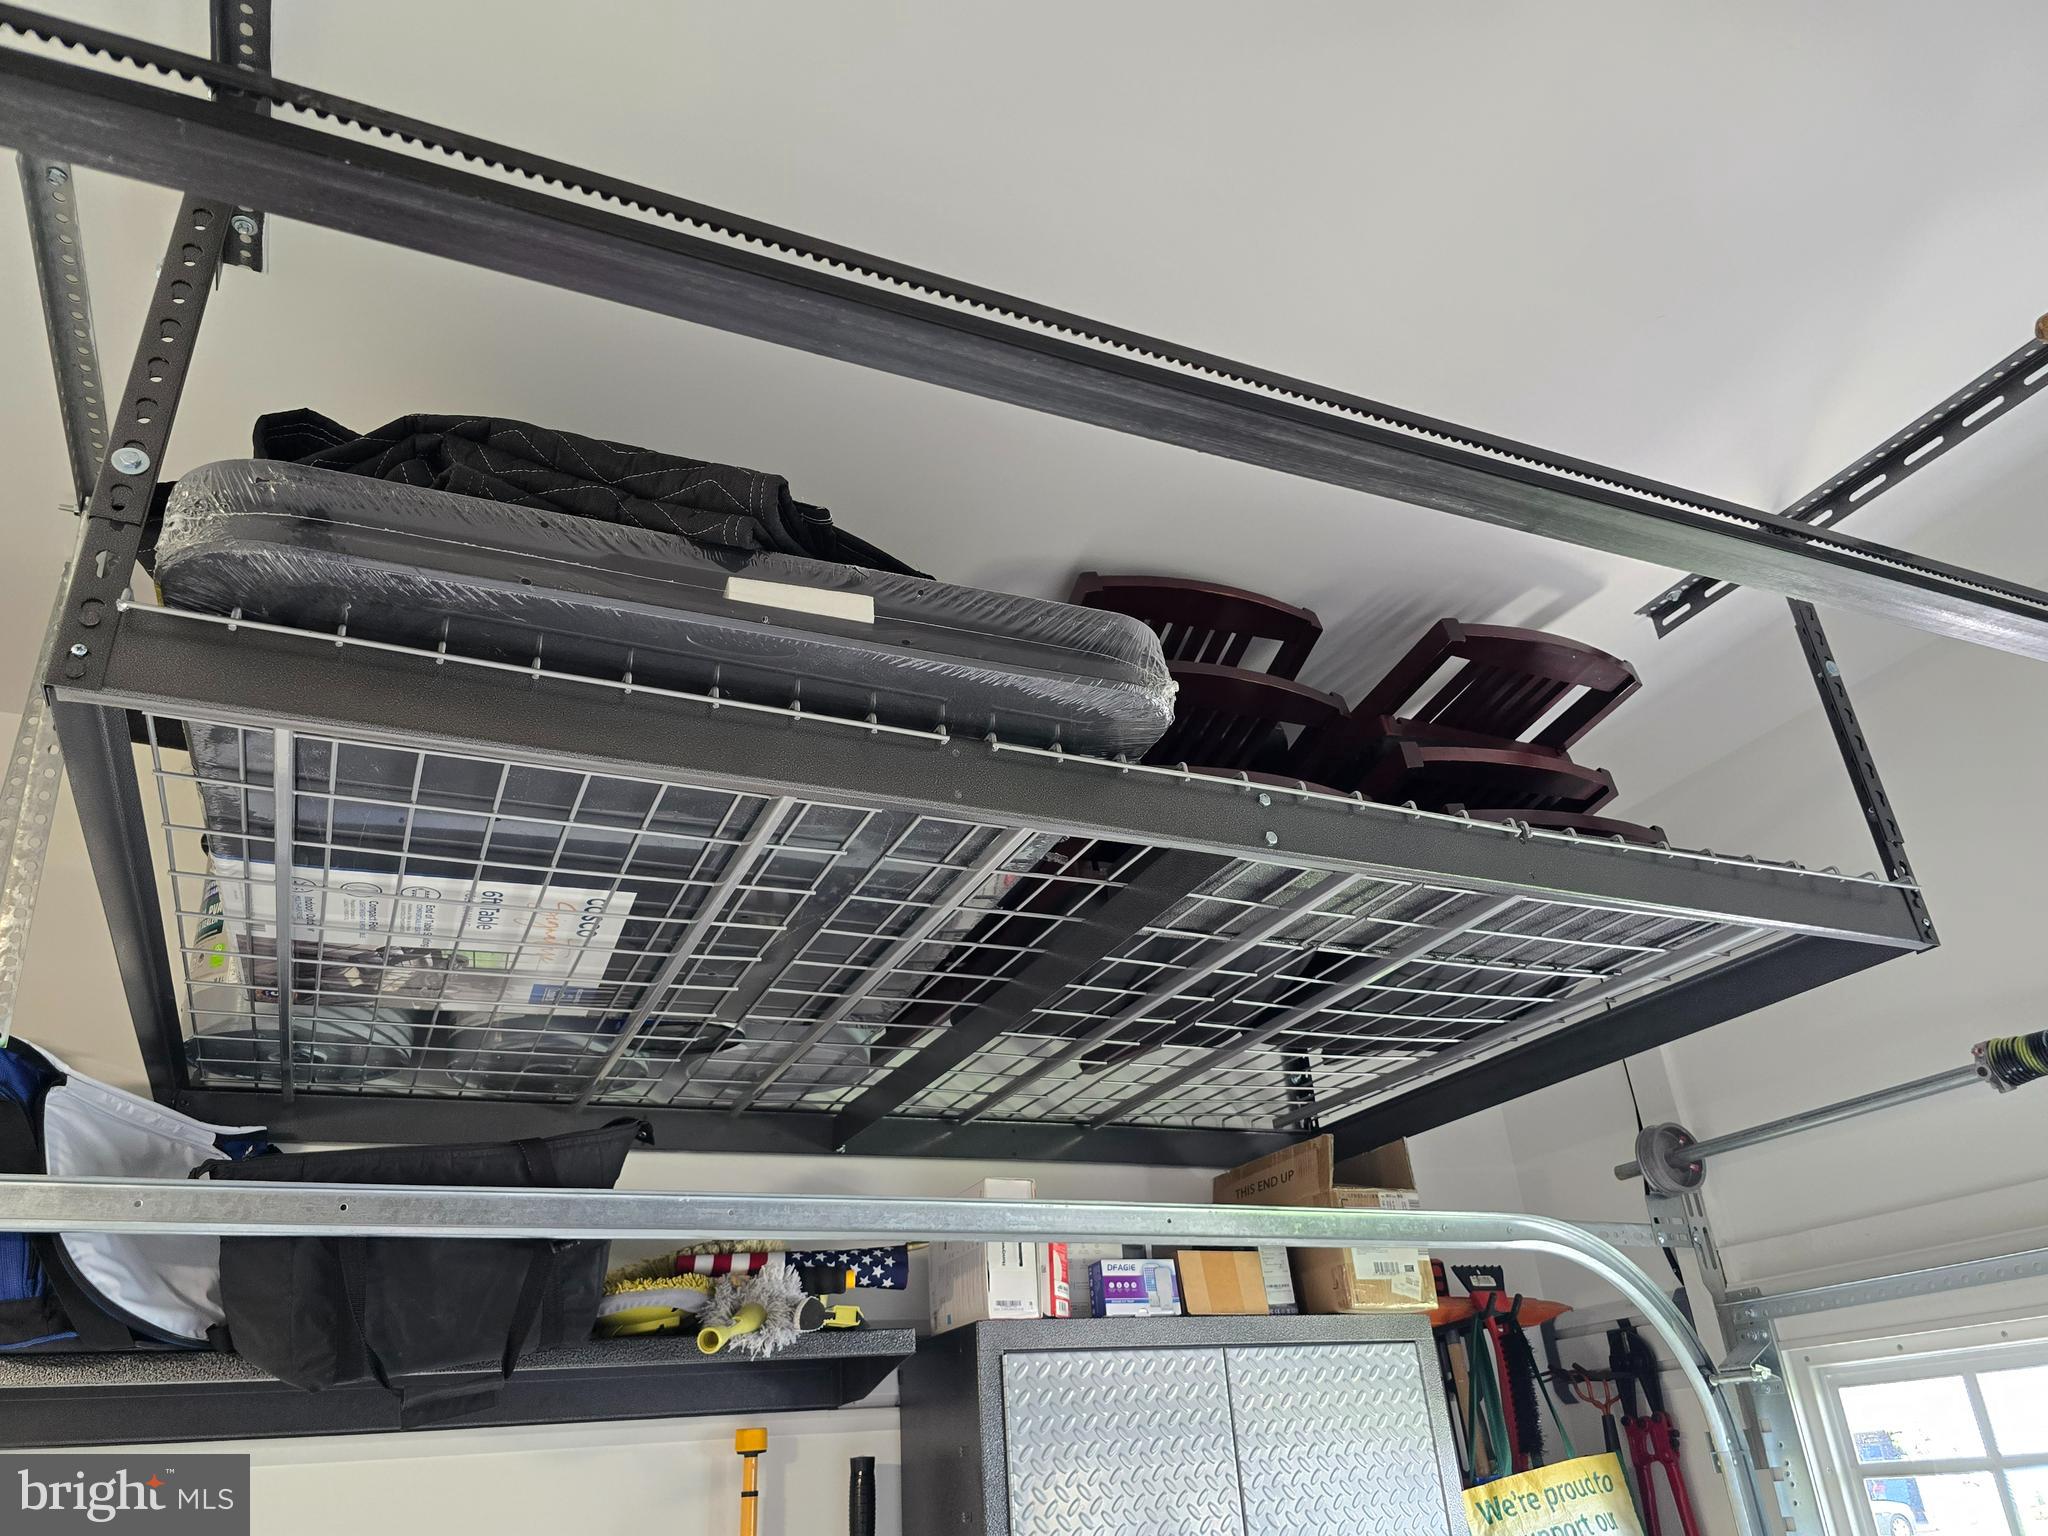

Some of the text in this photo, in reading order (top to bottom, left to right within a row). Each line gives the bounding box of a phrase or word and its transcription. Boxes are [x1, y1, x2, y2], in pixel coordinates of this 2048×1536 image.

[476, 890, 504, 930] 6ft Table
[1235, 1169, 1295, 1199] THIS END UP
[1475, 1471, 1614, 1526] We're proud to
